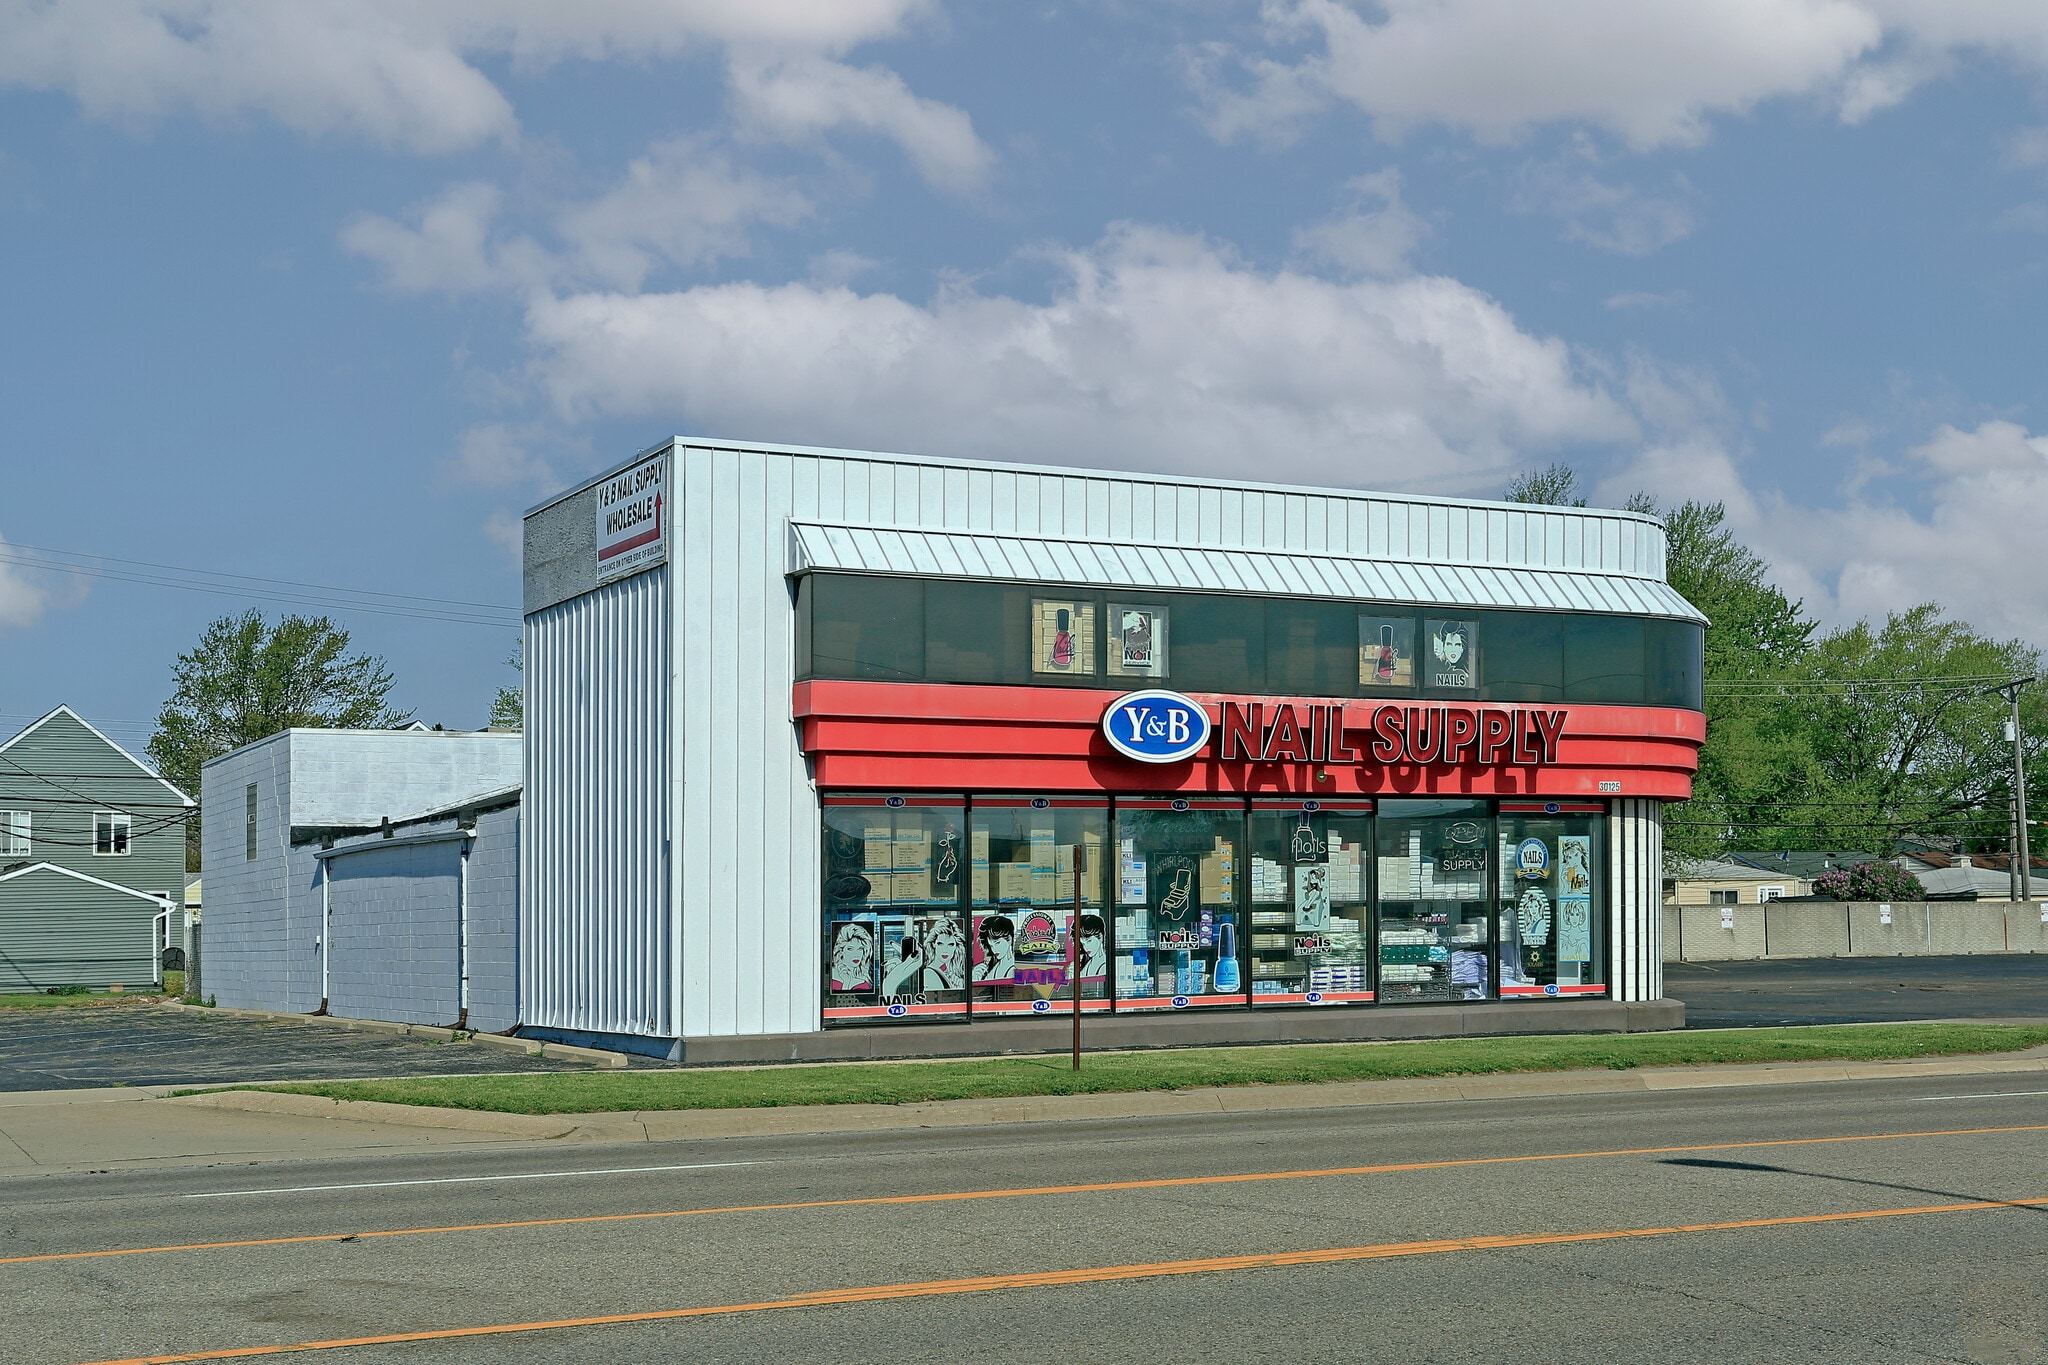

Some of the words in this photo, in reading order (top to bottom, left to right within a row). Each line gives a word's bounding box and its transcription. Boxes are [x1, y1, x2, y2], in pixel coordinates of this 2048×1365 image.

[599, 486, 604, 509] Y
[604, 485, 609, 507] &
[611, 482, 616, 504] B
[617, 474, 633, 500] NAIL
[635, 460, 663, 493] SUPPLY
[606, 496, 652, 536] WHOLESALE
[598, 561, 616, 575] ENTRANCE
[621, 554, 632, 567] OTHER
[632, 550, 641, 563] SIDE
[642, 549, 647, 560] OF
[647, 543, 663, 557] BUILDING
[1436, 673, 1466, 686] NAILS
[1124, 706, 1190, 744] Y&B
[1221, 701, 1355, 763] NAIL
[1372, 705, 1569, 764] SUPPLY
[1599, 782, 1620, 792] 30125
[1523, 850, 1543, 864] NAILS
[1443, 860, 1484, 871] SUPPLY
[1571, 873, 1589, 889] Nails
[1021, 942, 1057, 951] NAILS
[1523, 935, 1547, 946] NAILS
[1294, 947, 1331, 955] SUPPLY
[879, 993, 927, 1007] NAILS
